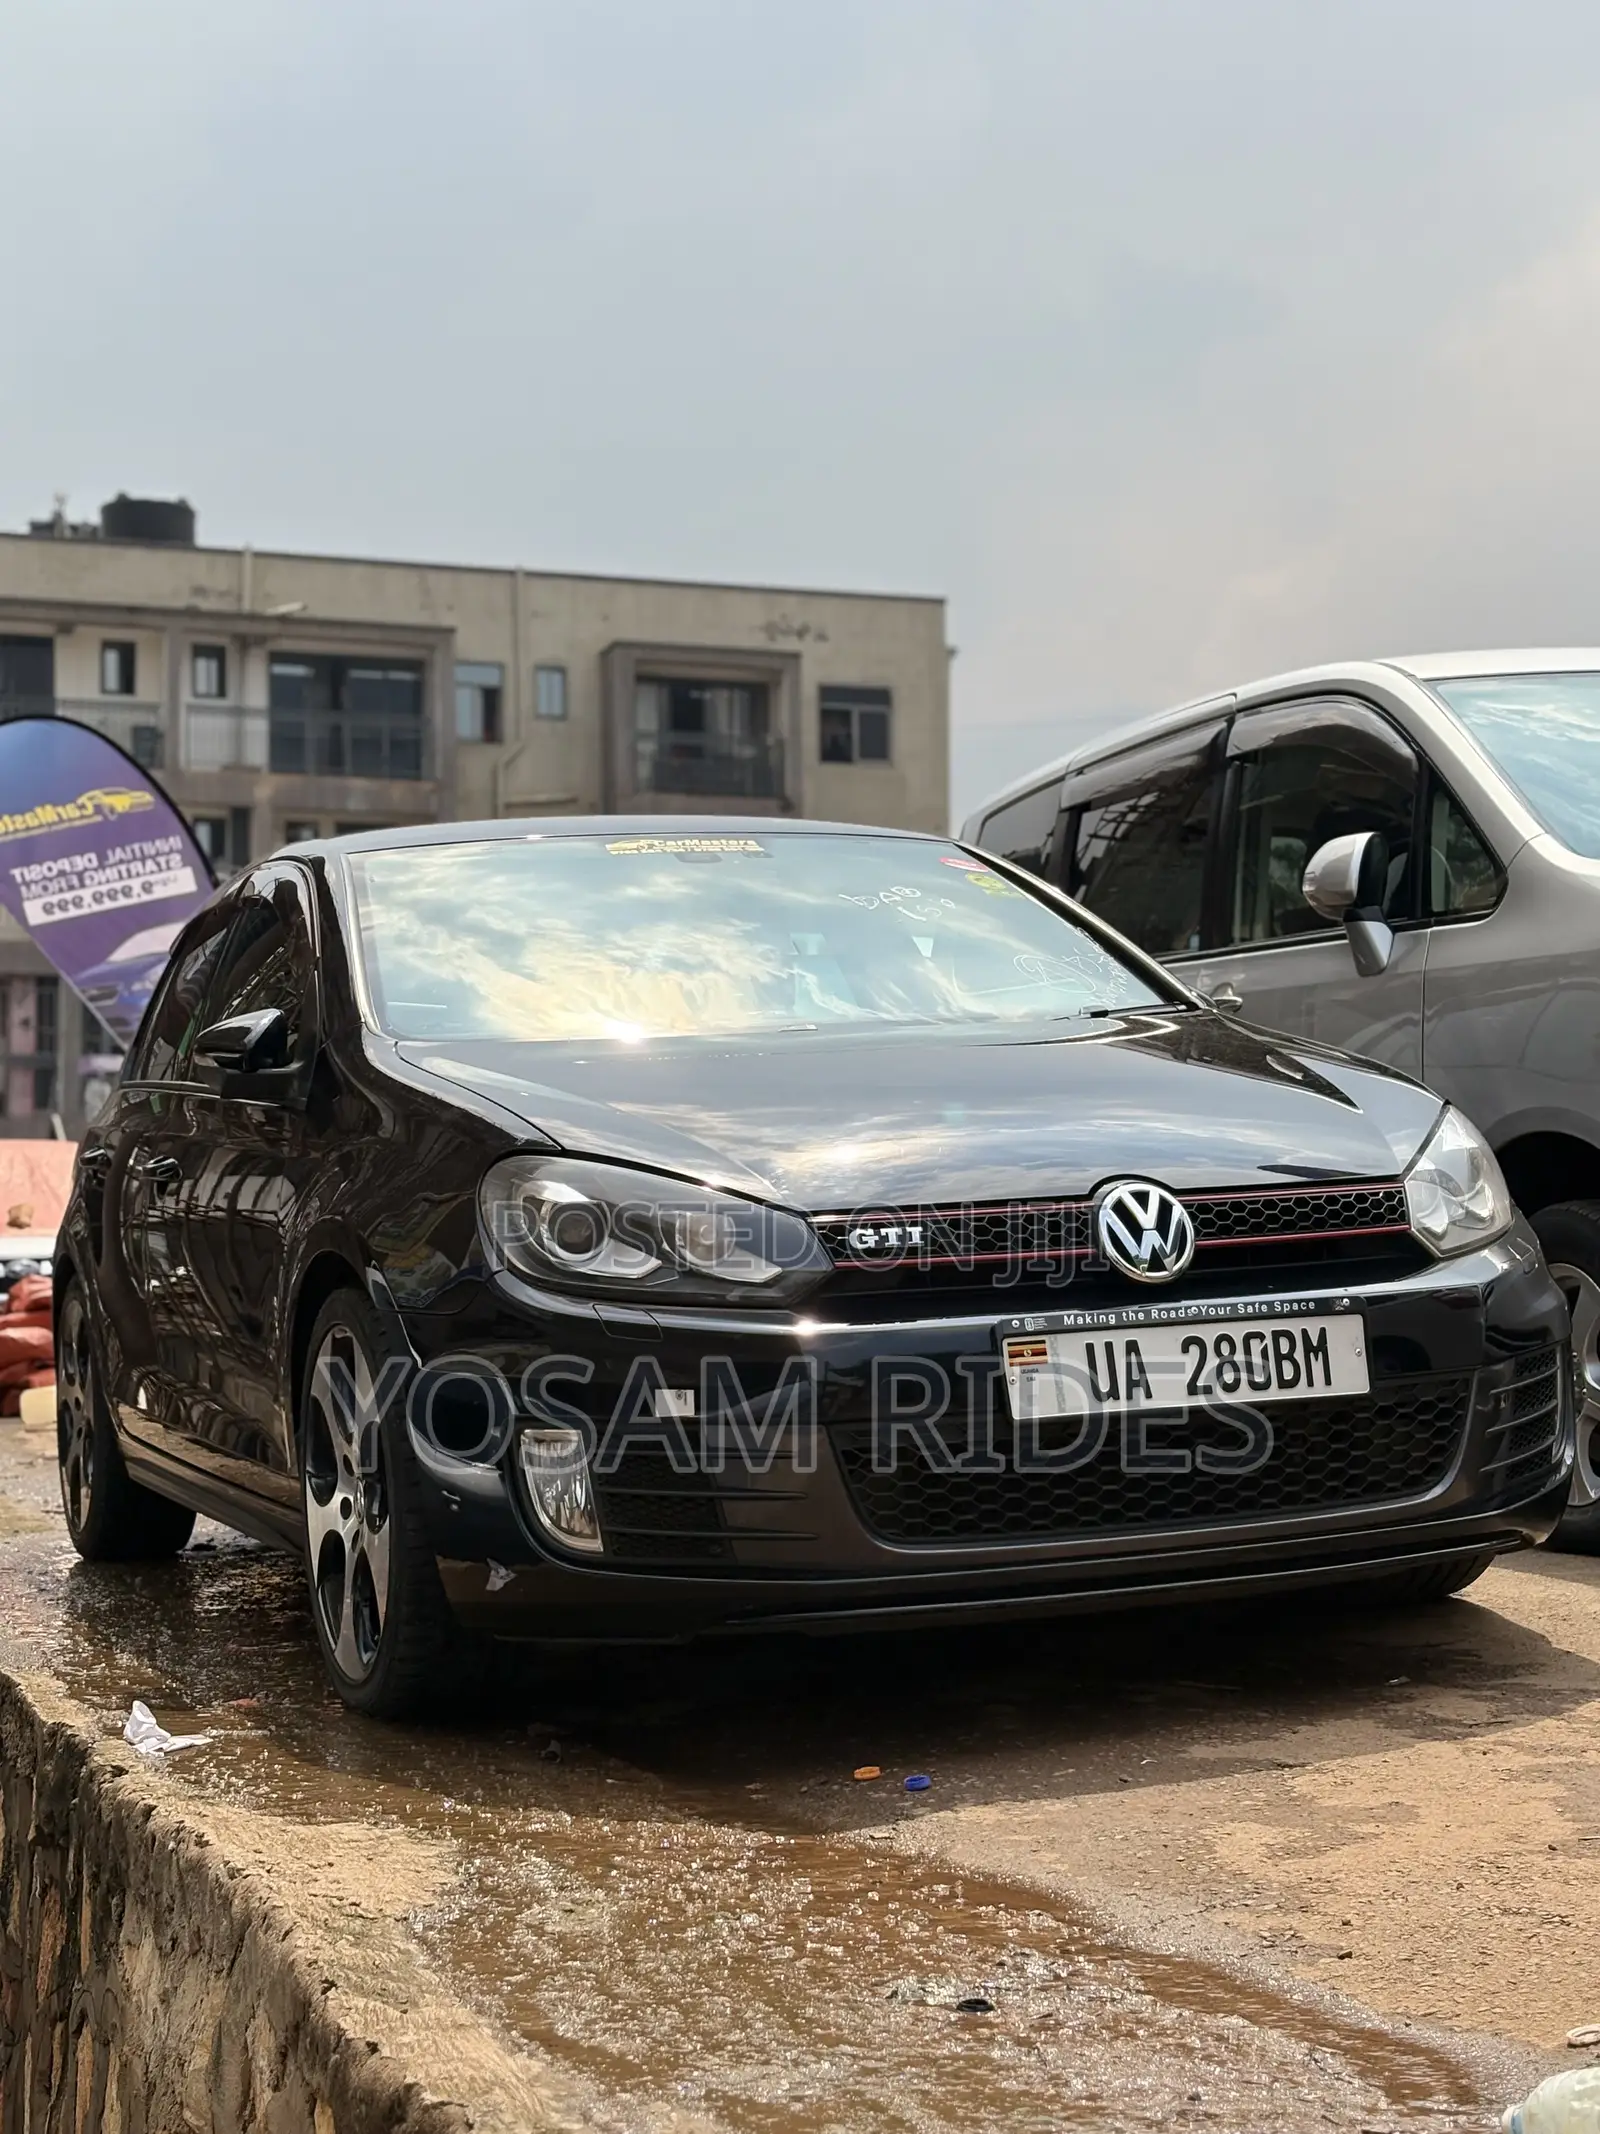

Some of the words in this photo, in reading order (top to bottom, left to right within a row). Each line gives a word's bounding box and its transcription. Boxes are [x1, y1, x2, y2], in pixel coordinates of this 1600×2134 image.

[849, 1227, 924, 1249] GTI
[1063, 1313, 1116, 1326] Making
[1122, 1310, 1145, 1322] the
[1151, 1306, 1193, 1320] Roads
[1200, 1304, 1232, 1316] Your
[1238, 1302, 1268, 1314] Safe
[1274, 1301, 1316, 1314] Space
[1085, 1338, 1153, 1402] UA
[1180, 1326, 1333, 1396] 280BM
